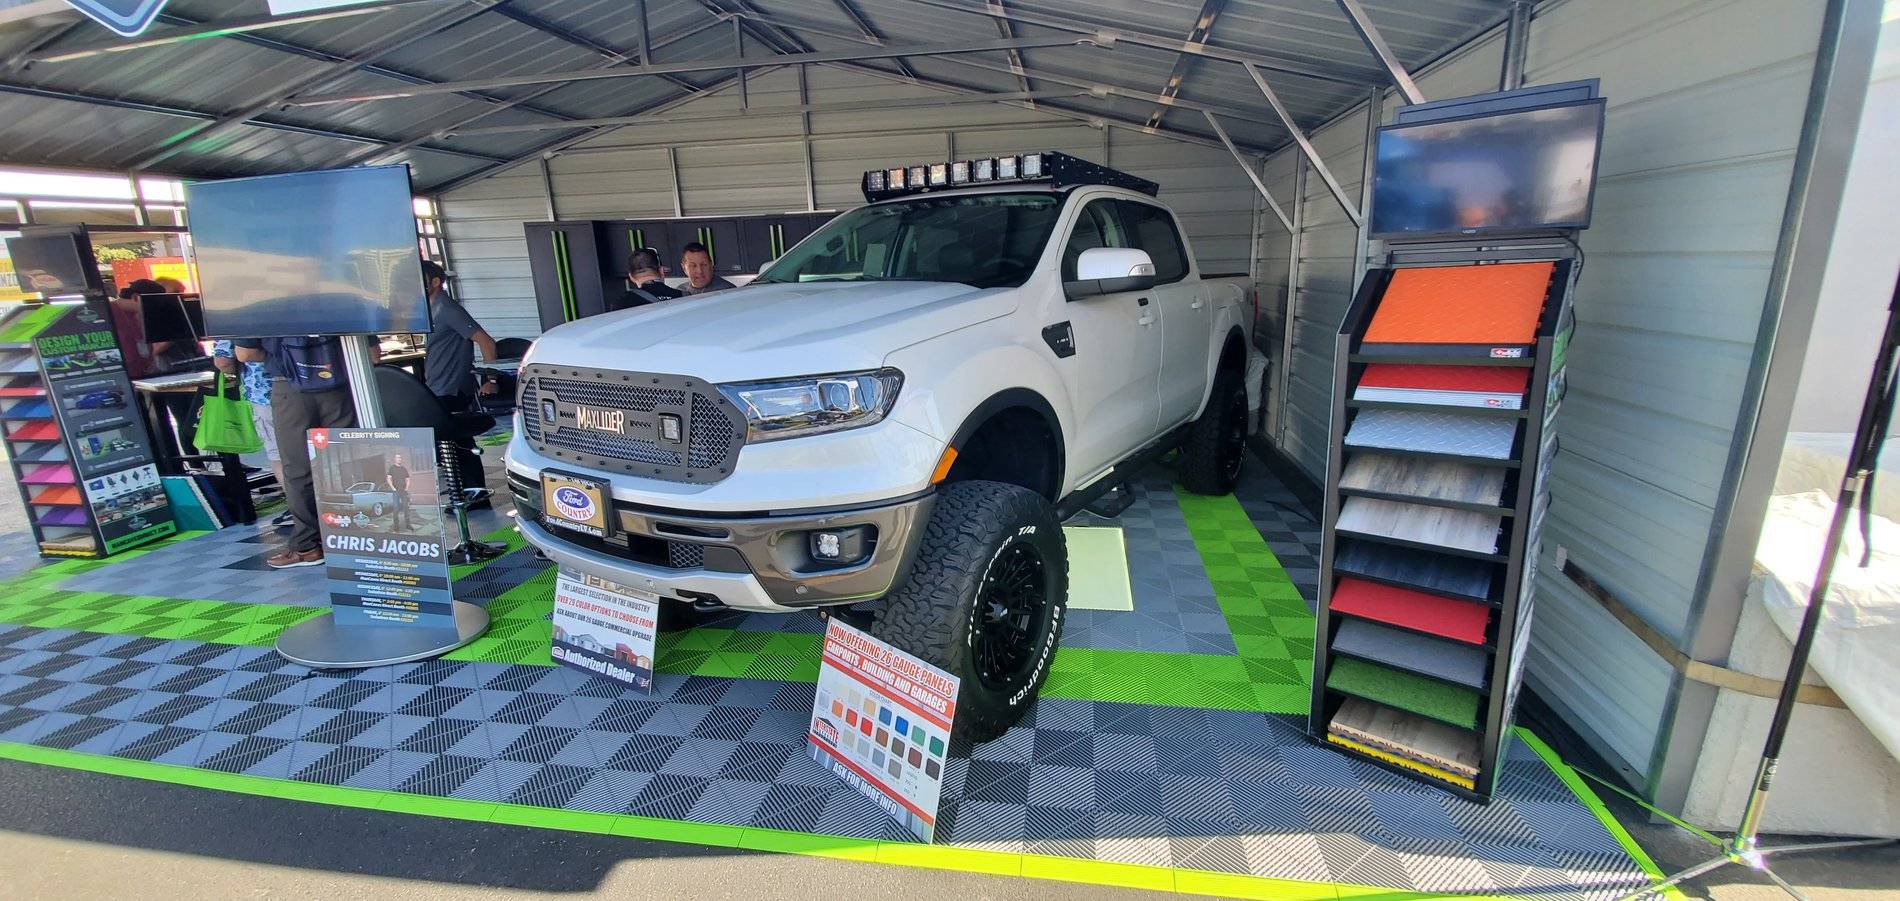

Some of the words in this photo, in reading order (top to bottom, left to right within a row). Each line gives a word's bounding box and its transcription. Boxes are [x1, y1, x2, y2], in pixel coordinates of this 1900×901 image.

[82, 330, 114, 343] YOUR
[339, 431, 373, 439] CELEBRITY
[374, 431, 400, 439] SIGNING
[576, 405, 625, 435] MAXLIDER
[556, 501, 593, 519] COUNTRY
[563, 489, 585, 506] Ford
[1018, 525, 1037, 536] T/A
[326, 534, 376, 553] CHRIS
[378, 538, 440, 558] JACOBS
[570, 585, 588, 596] LARGEST
[589, 590, 611, 602] SELECTION
[618, 598, 626, 607] THE
[626, 600, 650, 613] INDUSTRY
[575, 599, 591, 610] COLOR
[591, 604, 612, 617] OPTIONS
[619, 611, 640, 625] CHOOSE
[640, 618, 654, 629] FROM
[564, 610, 578, 620] ABOUT
[605, 621, 632, 636] COMMERCIAL
[631, 630, 652, 642] UPGRADE
[564, 649, 607, 673] Authorized
[606, 662, 635, 683] Dealer
[828, 622, 848, 642] NOW
[846, 632, 881, 660] OFFERING
[880, 648, 893, 666] 26
[892, 655, 921, 679] GAUGE
[921, 669, 955, 697] PANELS
[1009, 605, 1061, 706] BFGoodrich
[861, 659, 896, 686] BUILDING
[893, 677, 912, 694] AND
[910, 685, 948, 714] GARAGES
[832, 761, 848, 779] ASK
[846, 771, 861, 789] FOR
[859, 783, 881, 805] MORE
[880, 793, 898, 815] INFO
